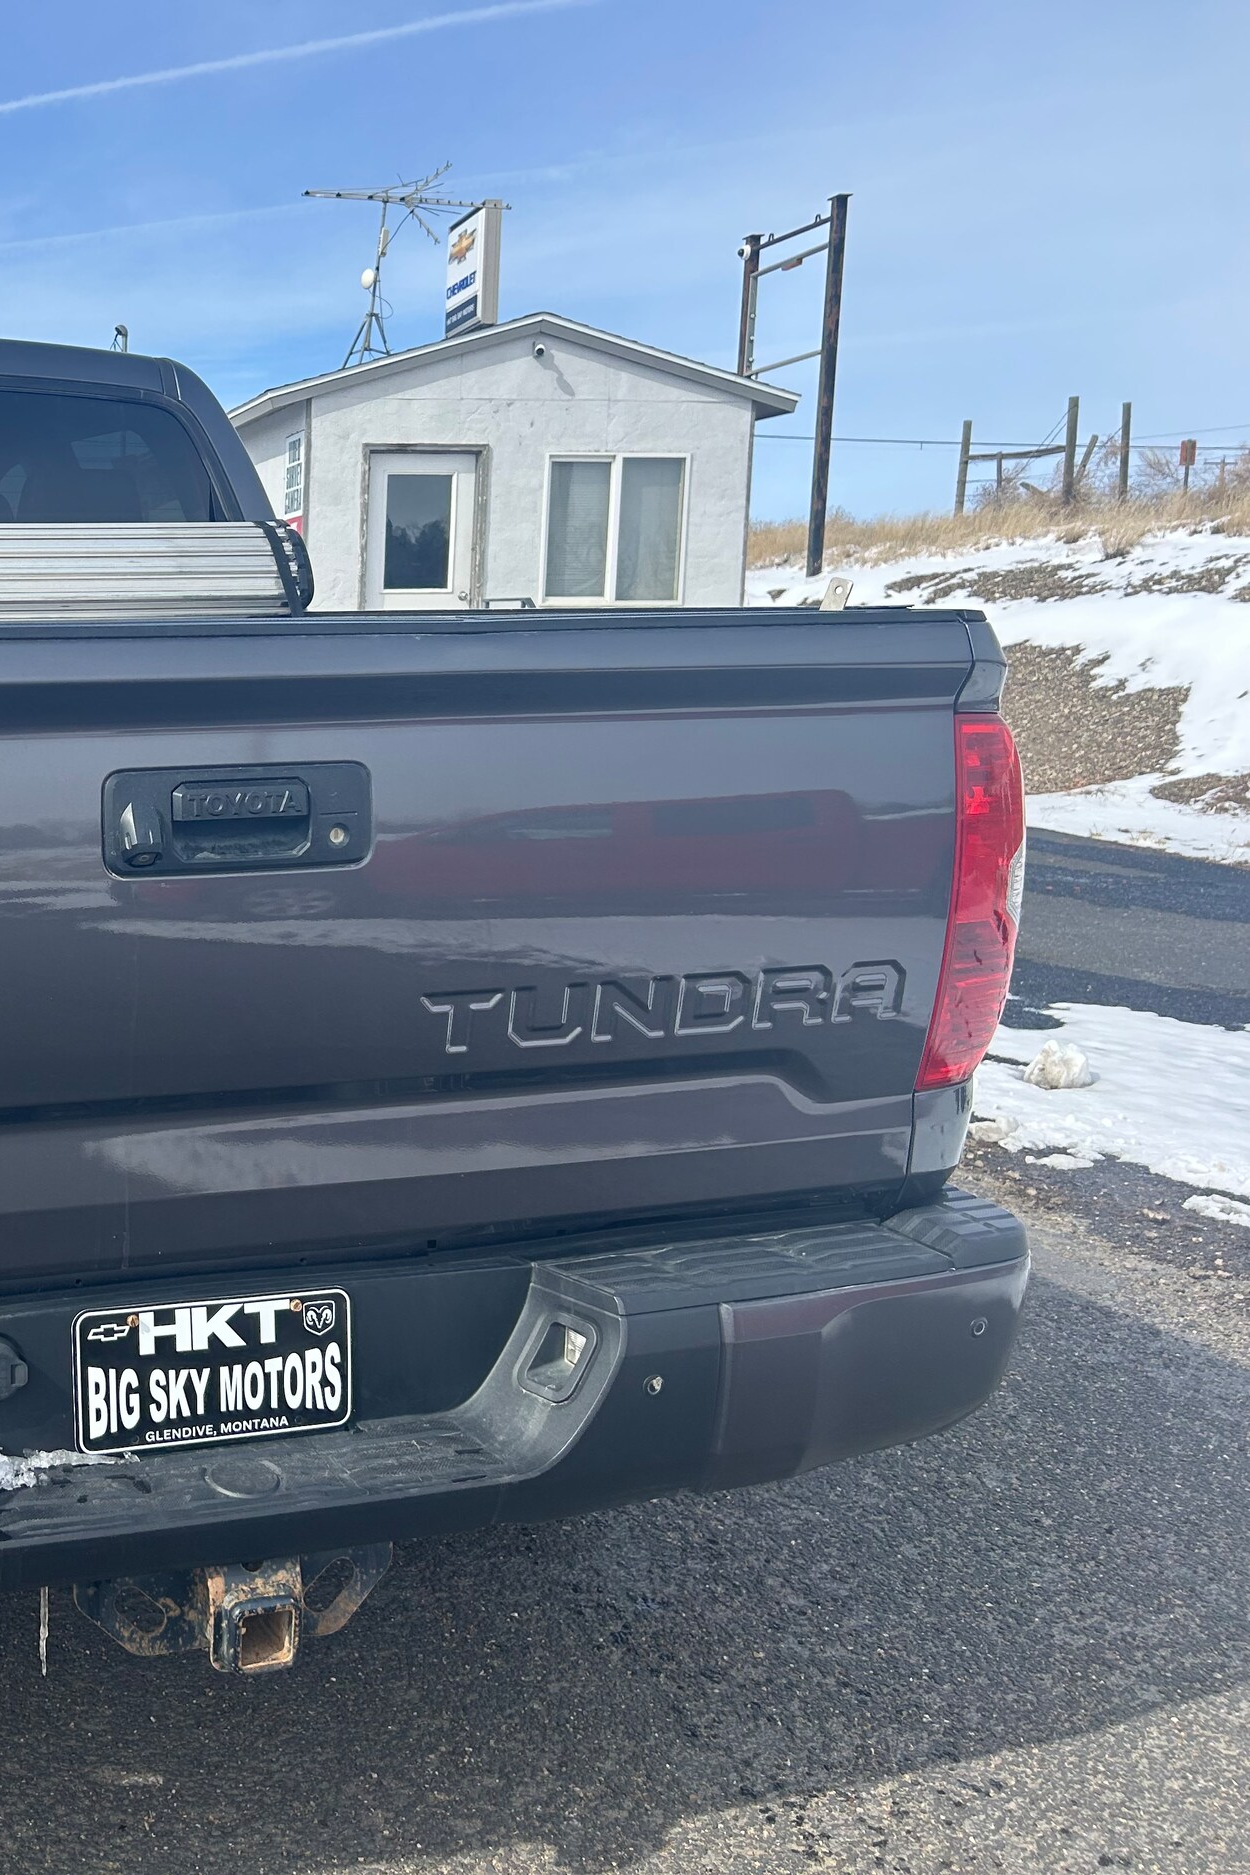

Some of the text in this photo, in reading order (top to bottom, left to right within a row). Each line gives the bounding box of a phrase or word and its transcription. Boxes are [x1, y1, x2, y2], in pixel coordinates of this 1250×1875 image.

[187, 790, 303, 817] TOYOTA
[419, 959, 907, 1054] TUNDRA
[138, 1299, 291, 1356] HKT
[87, 1366, 140, 1440] BIG
[149, 1367, 211, 1423] SKY
[220, 1341, 342, 1412] MOTORS
[145, 1415, 289, 1442] GLENDIVE, MONTANA
